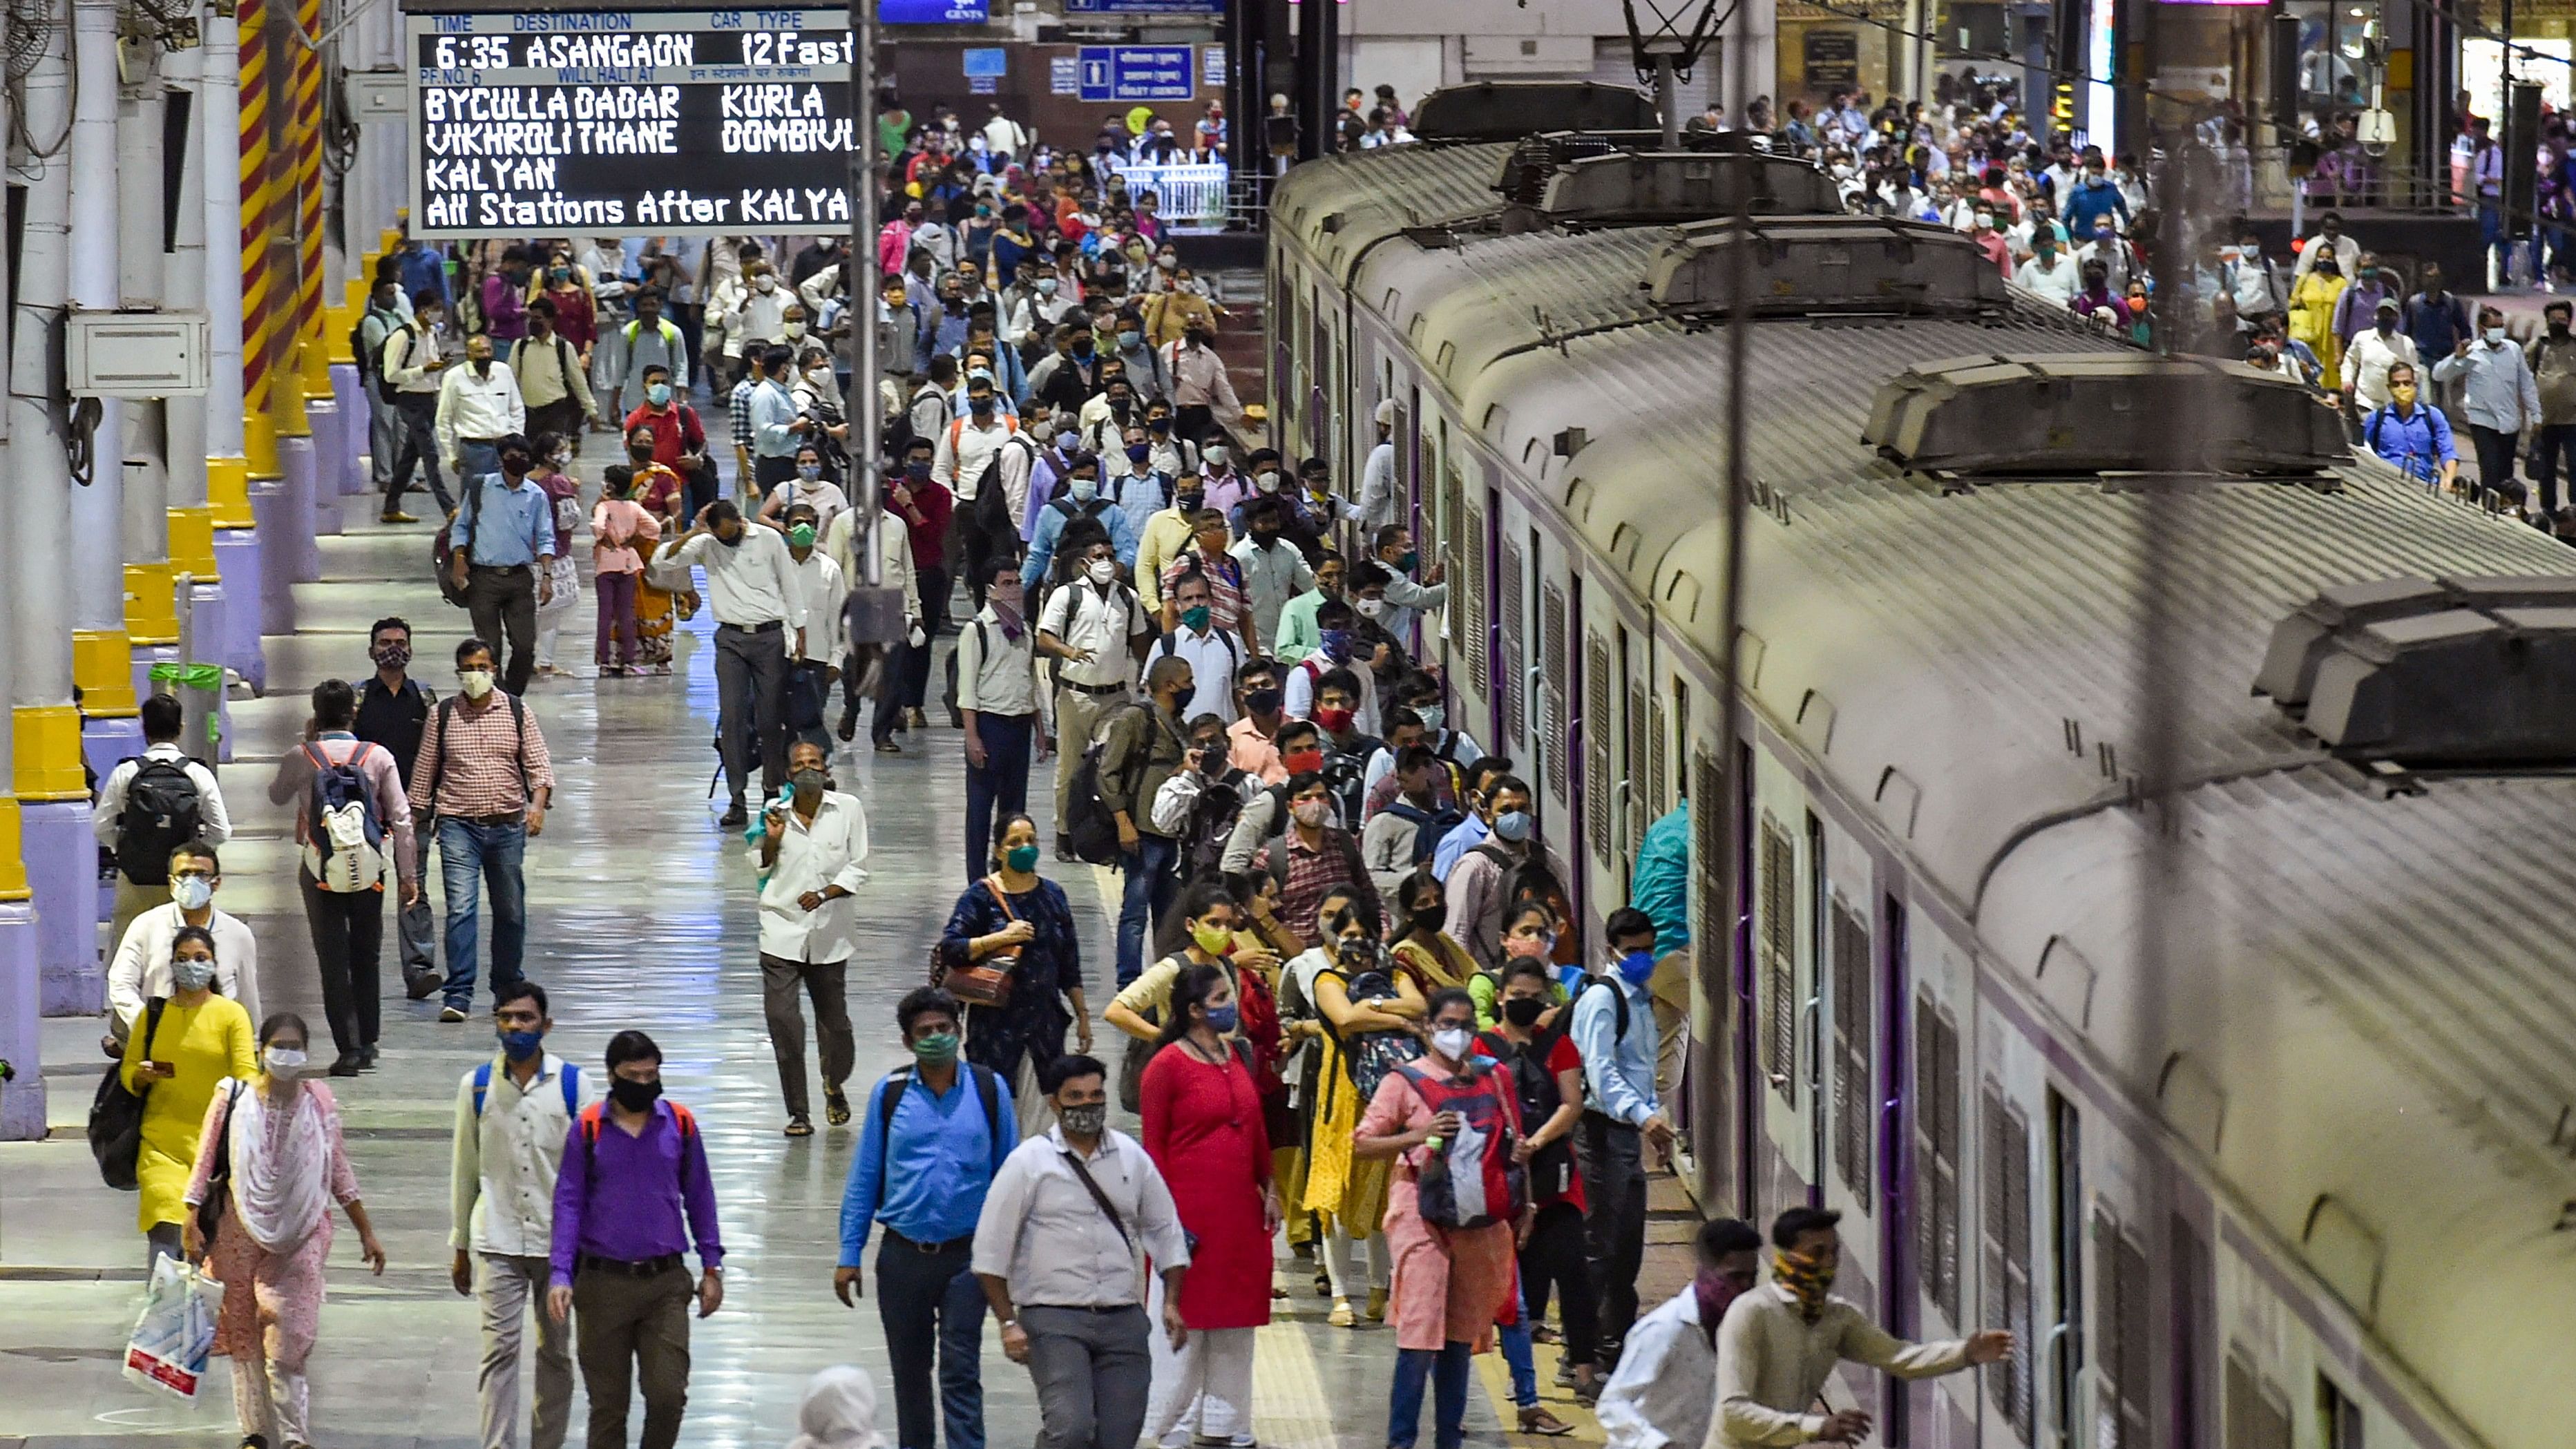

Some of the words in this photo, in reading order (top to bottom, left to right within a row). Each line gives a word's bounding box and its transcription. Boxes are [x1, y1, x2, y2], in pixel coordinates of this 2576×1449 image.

[432, 15, 473, 32] TIME
[514, 14, 631, 31] DESTINATION
[711, 12, 742, 28] CAR
[757, 12, 803, 29] TYPE
[436, 37, 509, 70] 6:35
[526, 34, 692, 68] ASANGAON
[471, 68, 481, 86] 6
[557, 66, 593, 84] WILL
[597, 66, 633, 83] HALT
[638, 65, 656, 82] AT
[426, 87, 569, 121] BYCULLA
[574, 86, 679, 119] DADAR
[721, 84, 824, 118] KURLA
[426, 122, 572, 155] VIKHROLI
[577, 121, 678, 154] THANE
[426, 157, 556, 191] KALYAN
[427, 193, 468, 226] All
[479, 191, 624, 225] Stations
[637, 190, 730, 222] After
